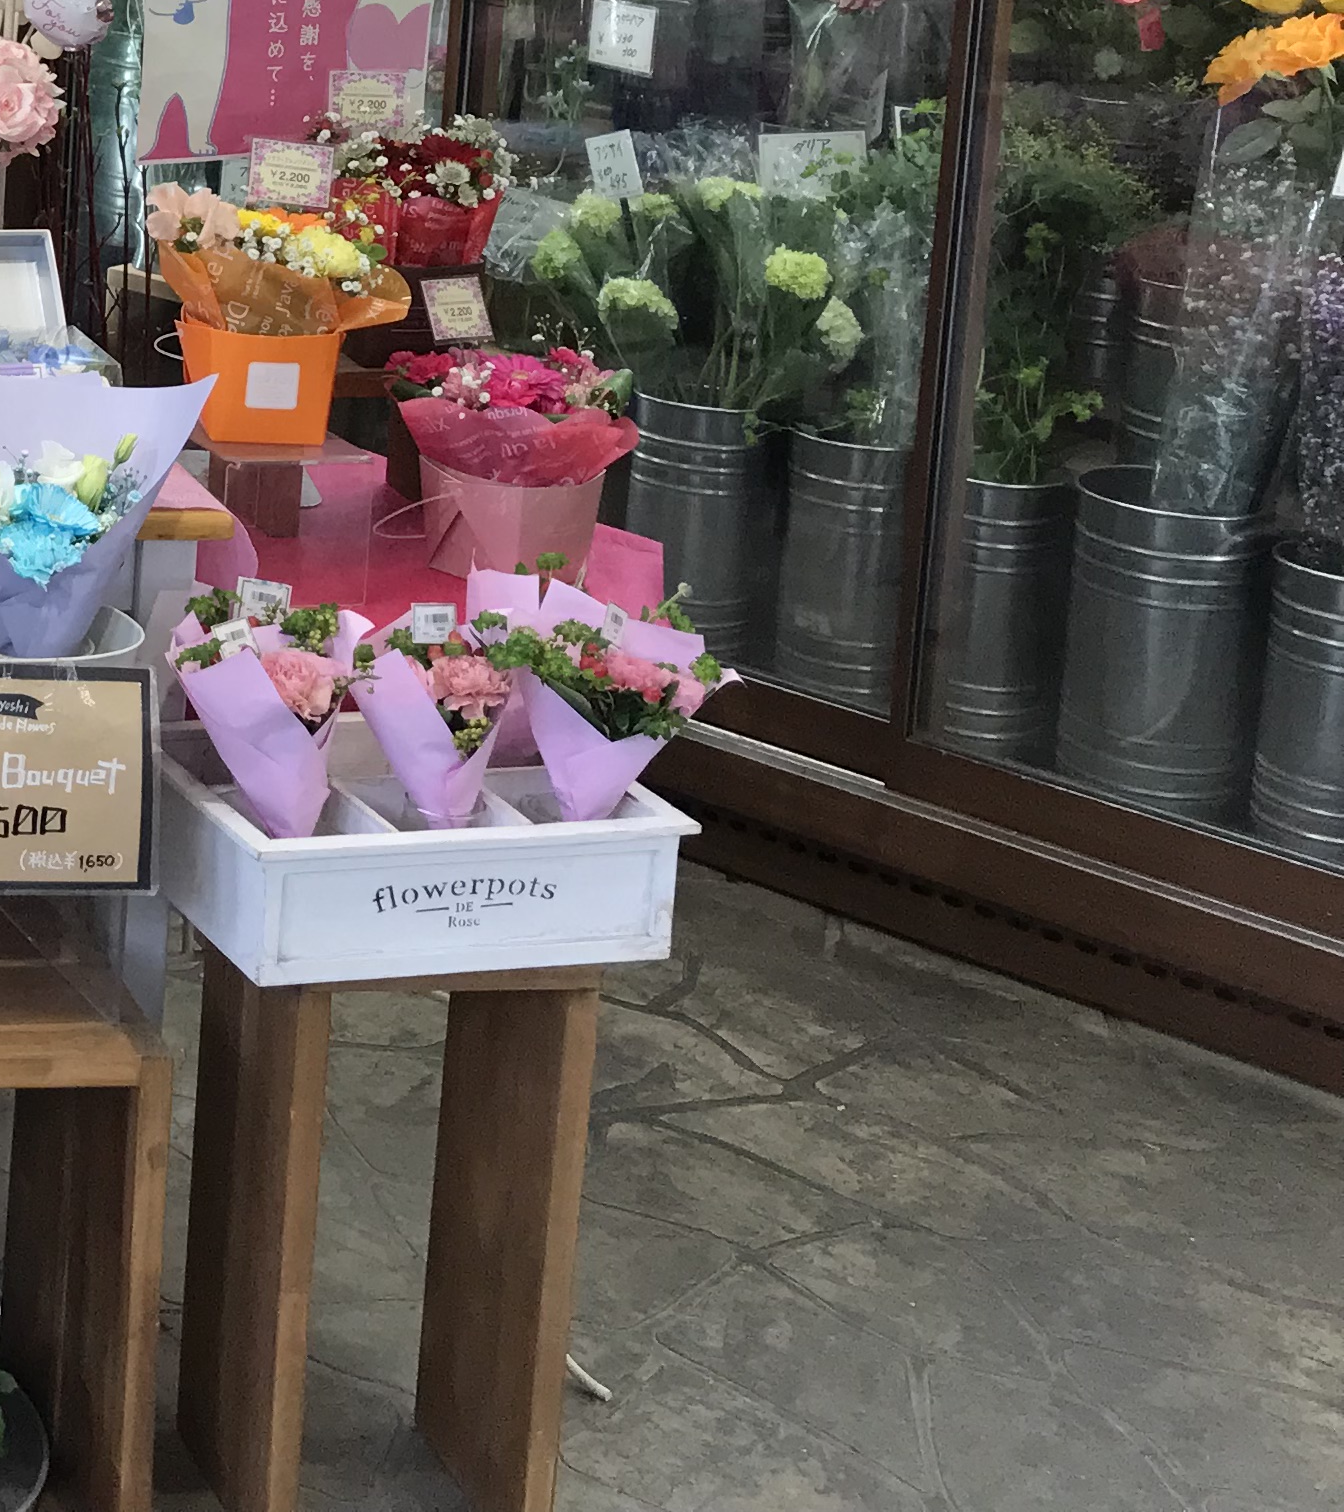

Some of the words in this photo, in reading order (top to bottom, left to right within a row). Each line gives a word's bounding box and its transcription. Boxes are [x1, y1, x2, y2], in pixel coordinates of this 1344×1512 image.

[46, 14, 82, 39] you
[15, 719, 57, 735] Flowers
[1, 751, 127, 795] Bouquet
[372, 875, 558, 914] flowerpots
[455, 901, 474, 913] DE
[447, 915, 481, 929] Rose
